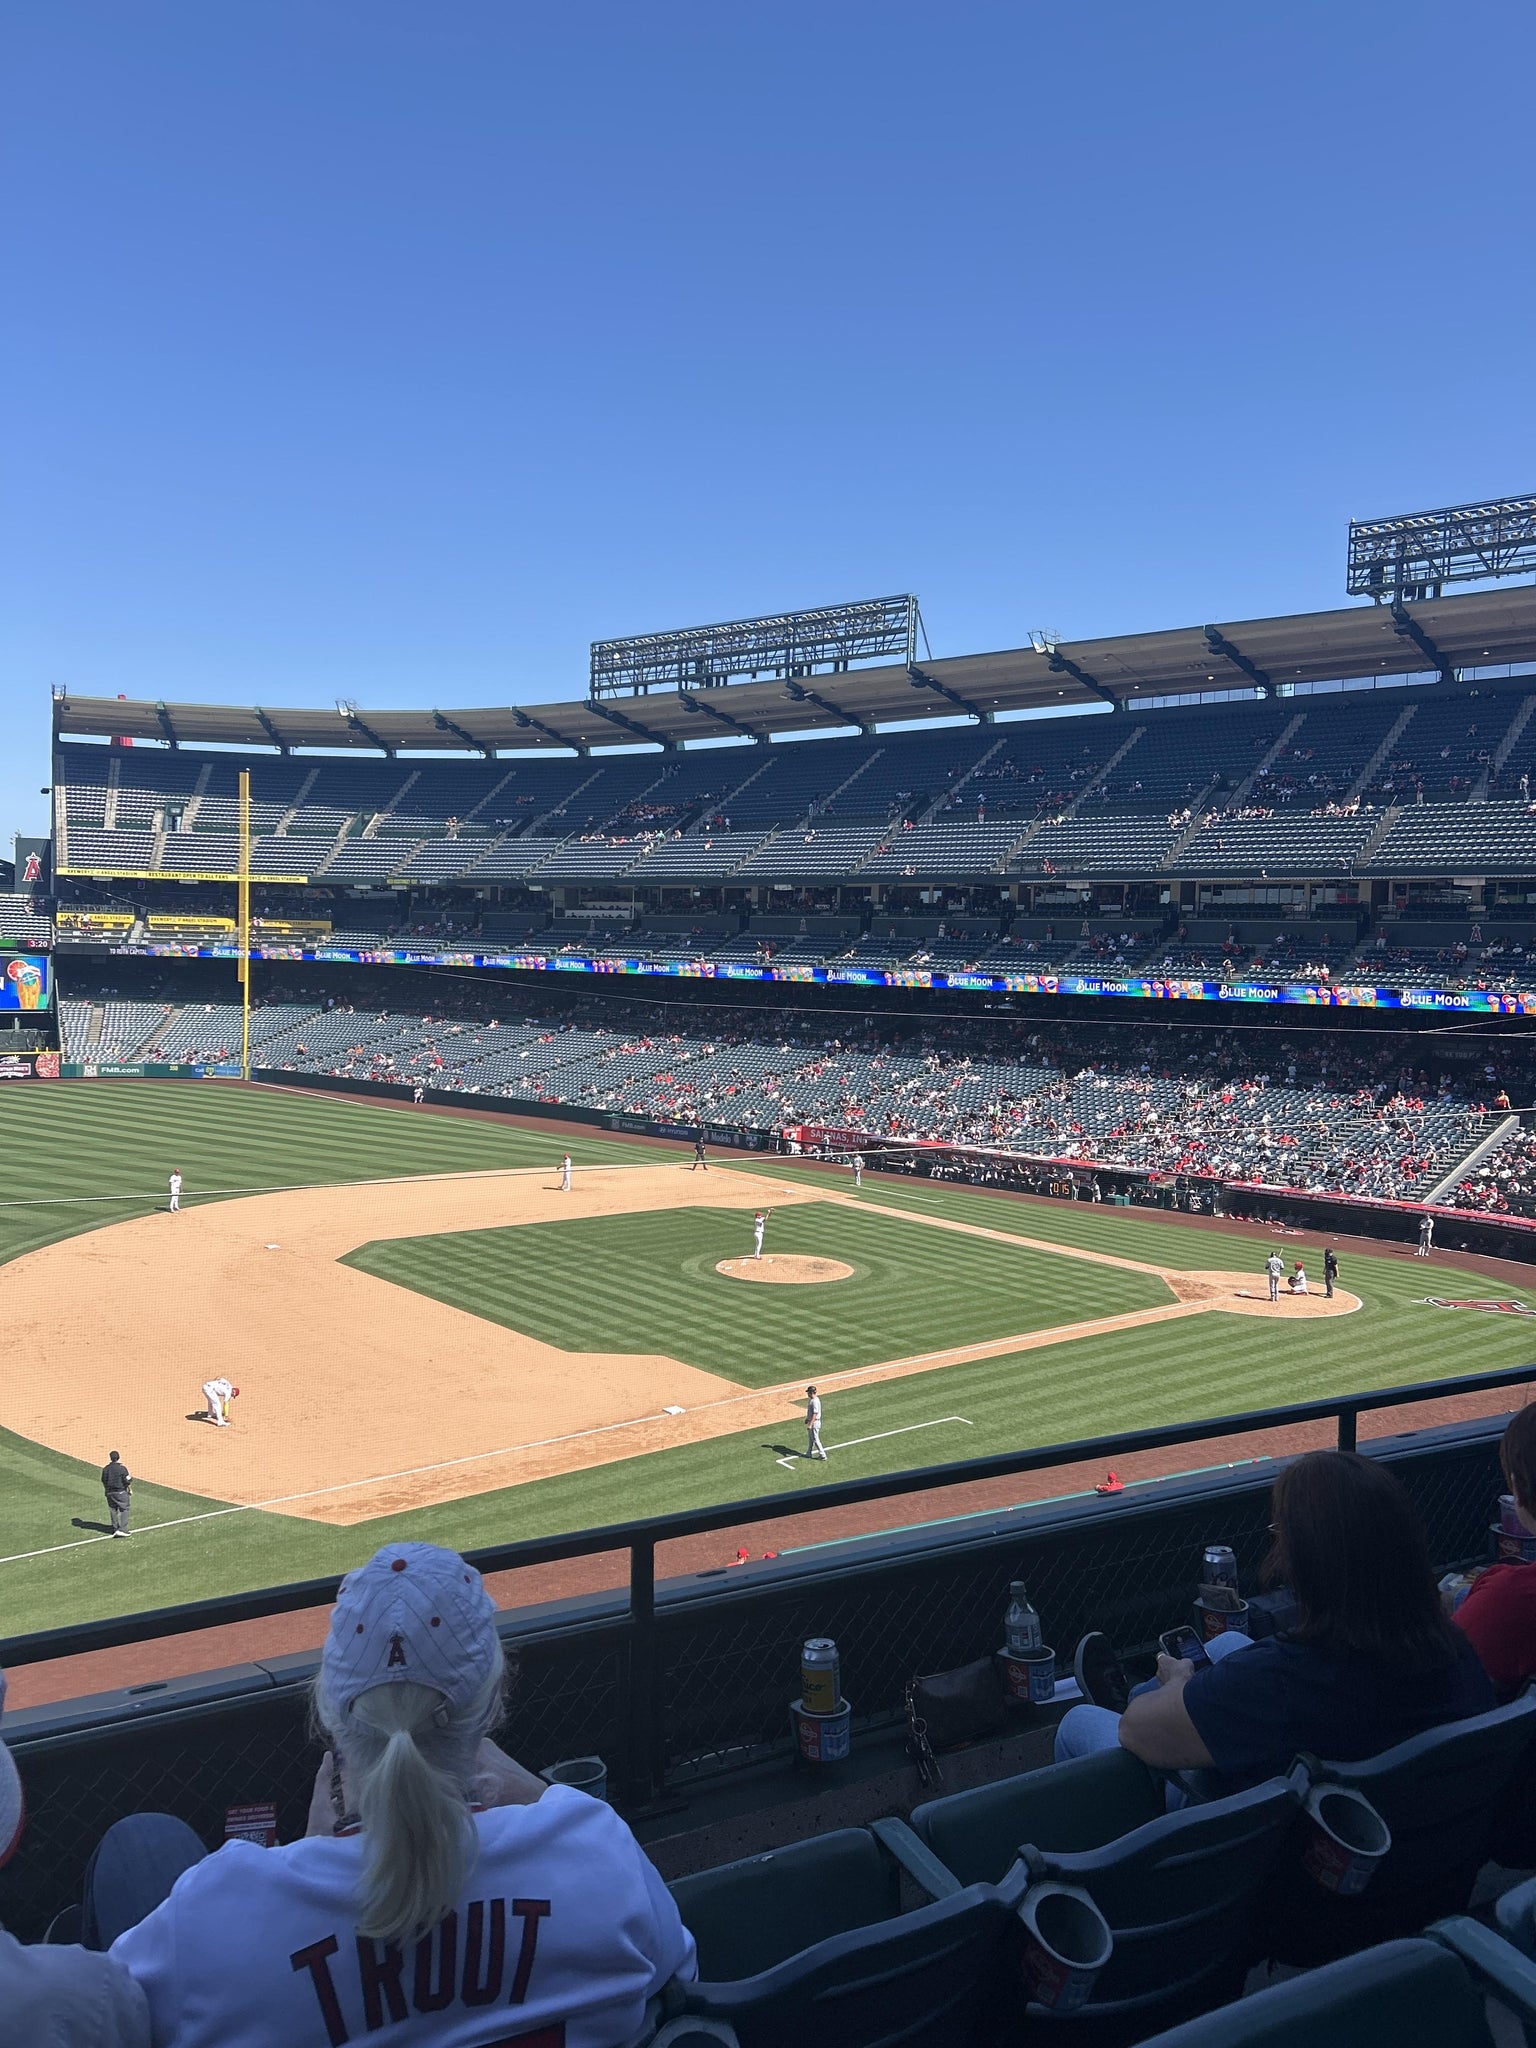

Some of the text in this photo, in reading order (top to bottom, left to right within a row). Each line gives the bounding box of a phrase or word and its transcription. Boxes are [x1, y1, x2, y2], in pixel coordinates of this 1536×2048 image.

[314, 950, 351, 960] BLUE MOON
[405, 953, 420, 963] BLUE
[482, 956, 495, 966] BLUE
[555, 959, 585, 969] BLUE MOON
[637, 962, 670, 973] BLUE MOON
[727, 966, 763, 977] BLUE MOON
[826, 969, 867, 982] BLUE MOON
[947, 974, 993, 987] BLUE MOON
[1076, 979, 1128, 993] BLUE MOON
[1219, 984, 1278, 999] BLUE MOON
[1400, 991, 1470, 1007] BLUE MOON
[101, 1066, 139, 1074] FMB.com
[711, 1131, 731, 1144] Modelo
[810, 1129, 849, 1143] SALNAS,
[290, 1897, 551, 2048] TROUT
